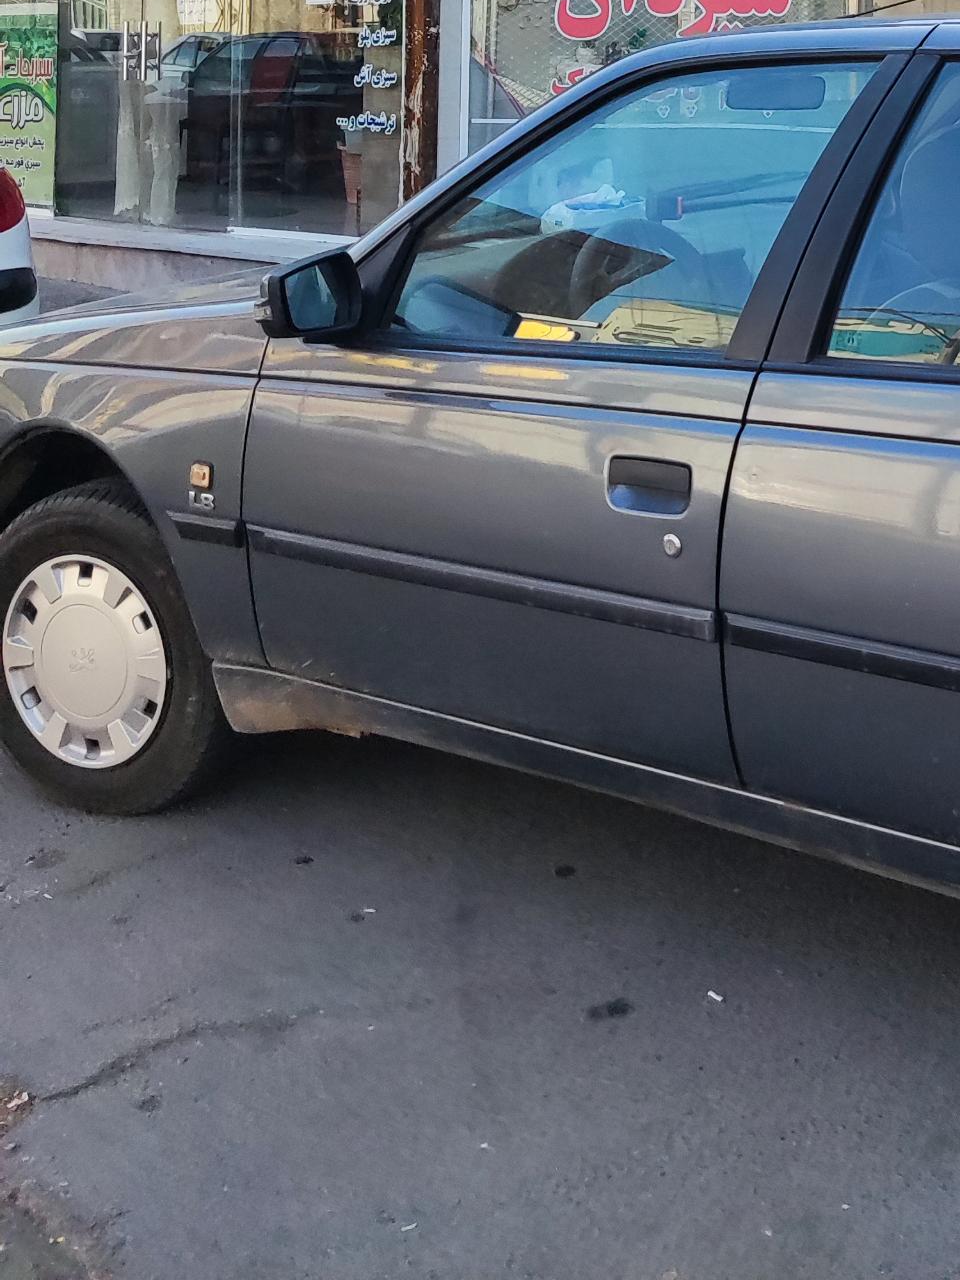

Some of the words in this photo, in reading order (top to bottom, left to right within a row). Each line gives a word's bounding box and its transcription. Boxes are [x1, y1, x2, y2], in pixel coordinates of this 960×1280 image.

[371, 25, 396, 46] سبزی
[354, 64, 373, 87] آش
[371, 68, 397, 88] سبزی
